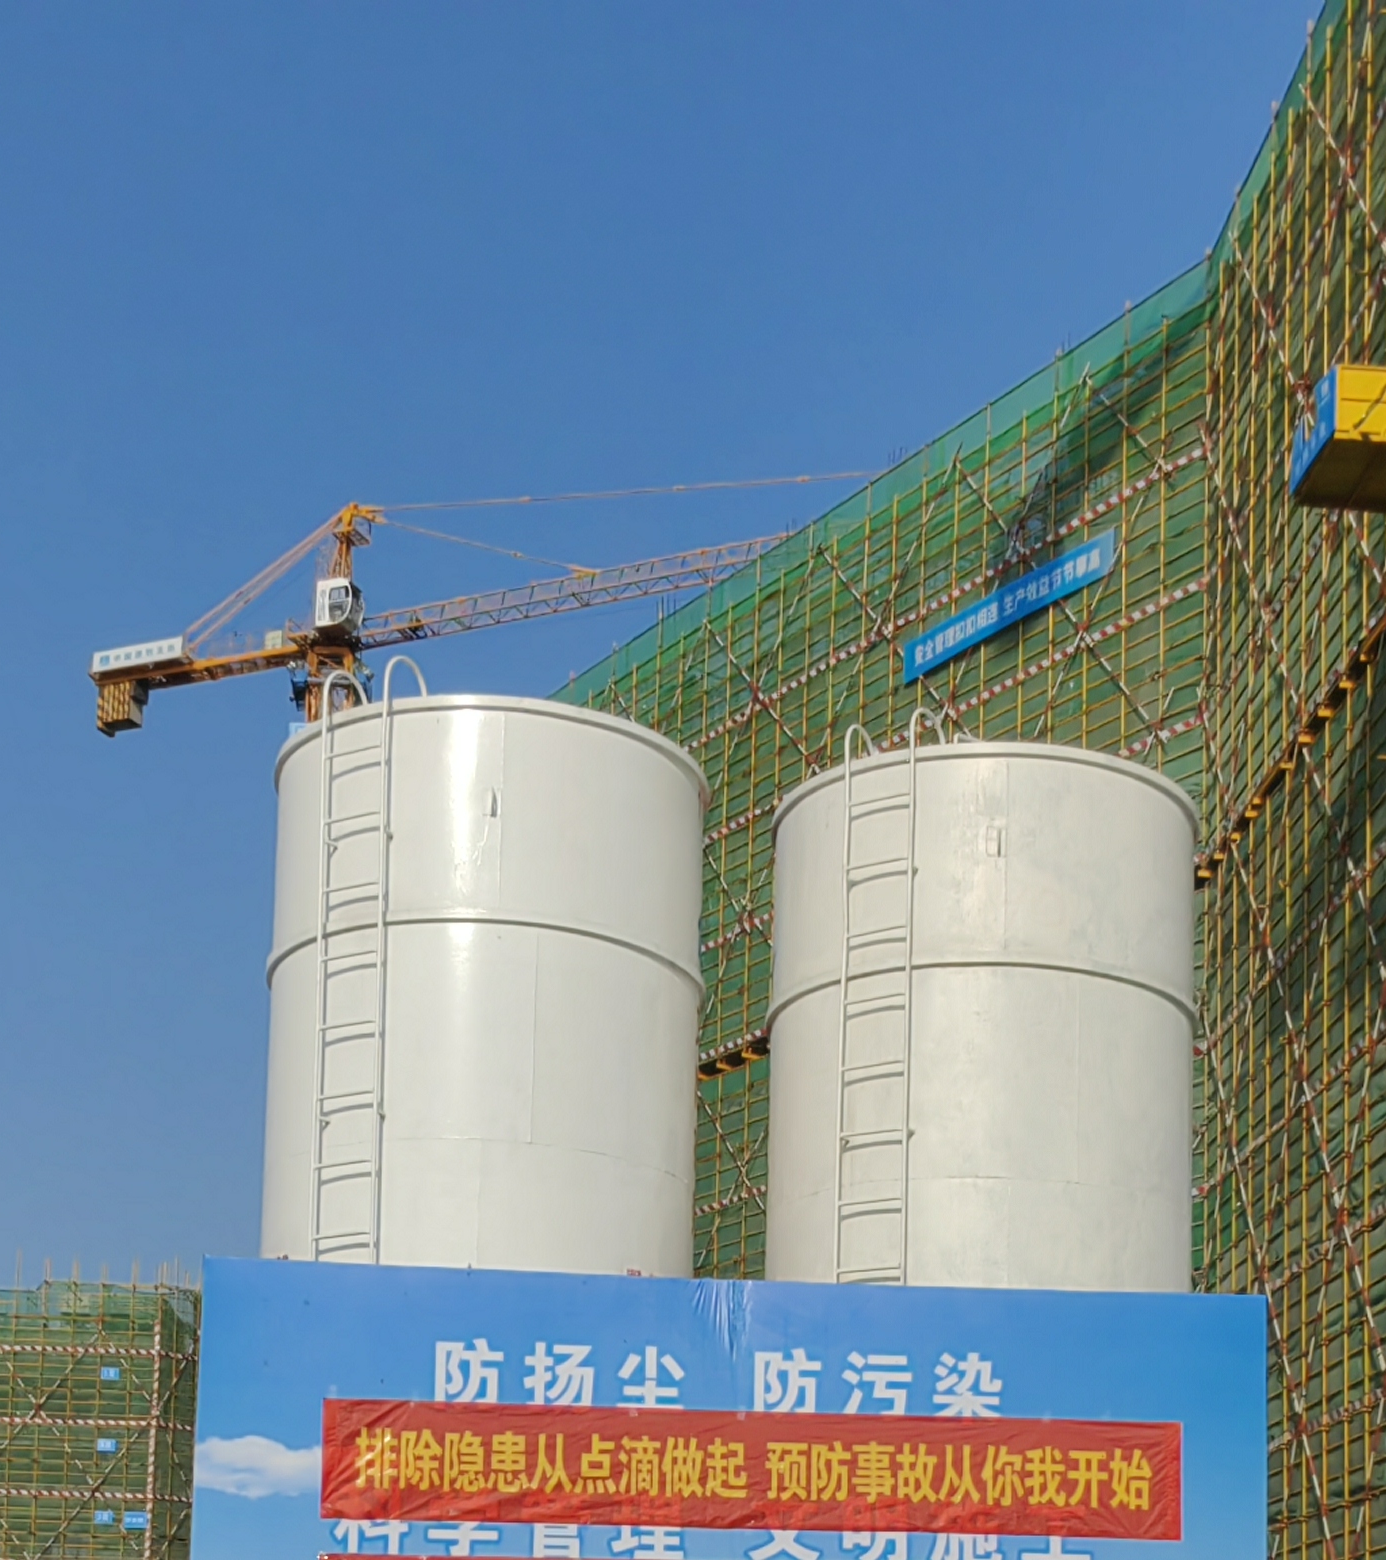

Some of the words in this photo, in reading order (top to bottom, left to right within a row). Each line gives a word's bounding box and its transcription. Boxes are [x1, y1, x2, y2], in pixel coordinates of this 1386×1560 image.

[435, 1338, 686, 1409] 防扬尘
[754, 1348, 1002, 1417] 防污染
[355, 1427, 748, 1498] 排除隐患从点滴做起
[765, 1441, 1153, 1510] 预防事故从你我开始
